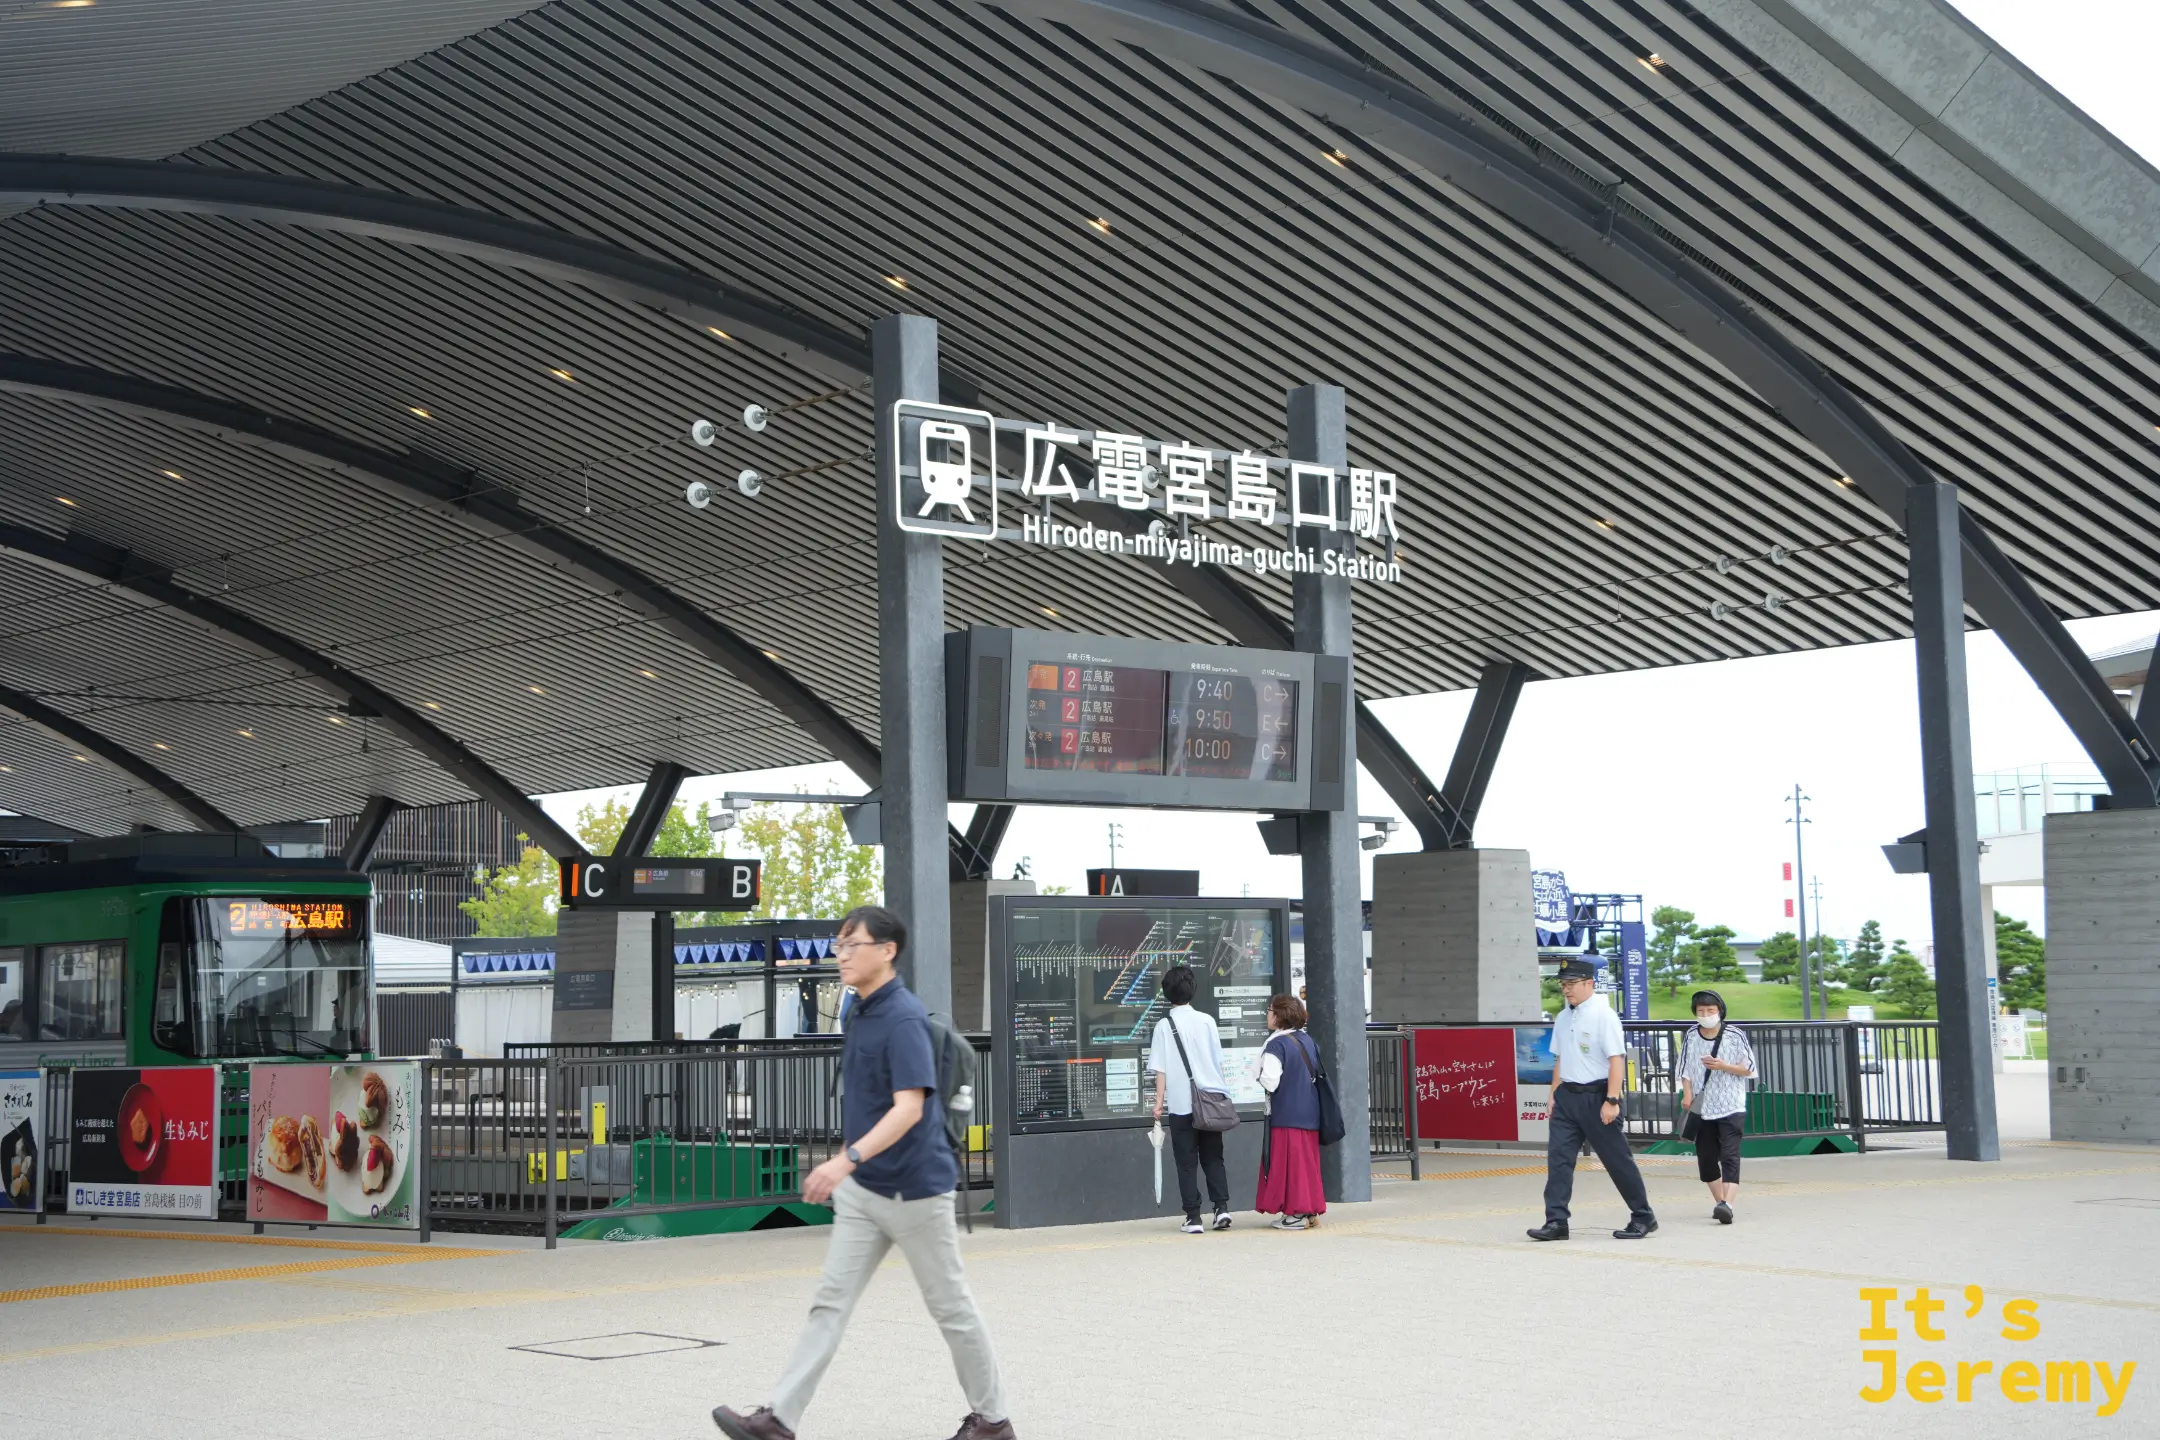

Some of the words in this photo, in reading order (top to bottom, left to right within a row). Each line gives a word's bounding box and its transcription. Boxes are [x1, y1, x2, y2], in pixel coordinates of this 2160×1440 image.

[1020, 422, 1401, 542] 広電宮島口駅
[1023, 513, 1315, 574] Hiroden-miyajima-guchi
[1323, 549, 1401, 582] Station
[1067, 670, 1077, 689] 2
[1082, 669, 1114, 684] 広島駅
[1197, 678, 1232, 701] 9:40
[1263, 685, 1273, 702] C
[1029, 699, 1046, 710] 次発
[1066, 701, 1076, 720] 2
[1081, 700, 1113, 714] 広島駅
[1196, 708, 1232, 730] 9:50
[1262, 714, 1272, 732] E
[1065, 731, 1073, 750] 2
[1080, 731, 1112, 745] 広島駅
[1186, 738, 1231, 760] 10:00
[1261, 743, 1270, 761] C
[584, 863, 605, 898] C
[732, 865, 751, 898] B
[1111, 875, 1124, 896] A
[1532, 873, 1564, 890] 宮島から
[251, 903, 301, 911] HIROSHIMA
[304, 903, 343, 911] STATION
[231, 904, 246, 930] 2
[289, 910, 344, 929] 広島駅
[38, 1053, 77, 1067] Green
[82, 1051, 117, 1067] Liner
[164, 1119, 209, 1141] 生もみじ
[392, 1085, 404, 1163] もみじ
[179, 1193, 203, 1210] 目の前
